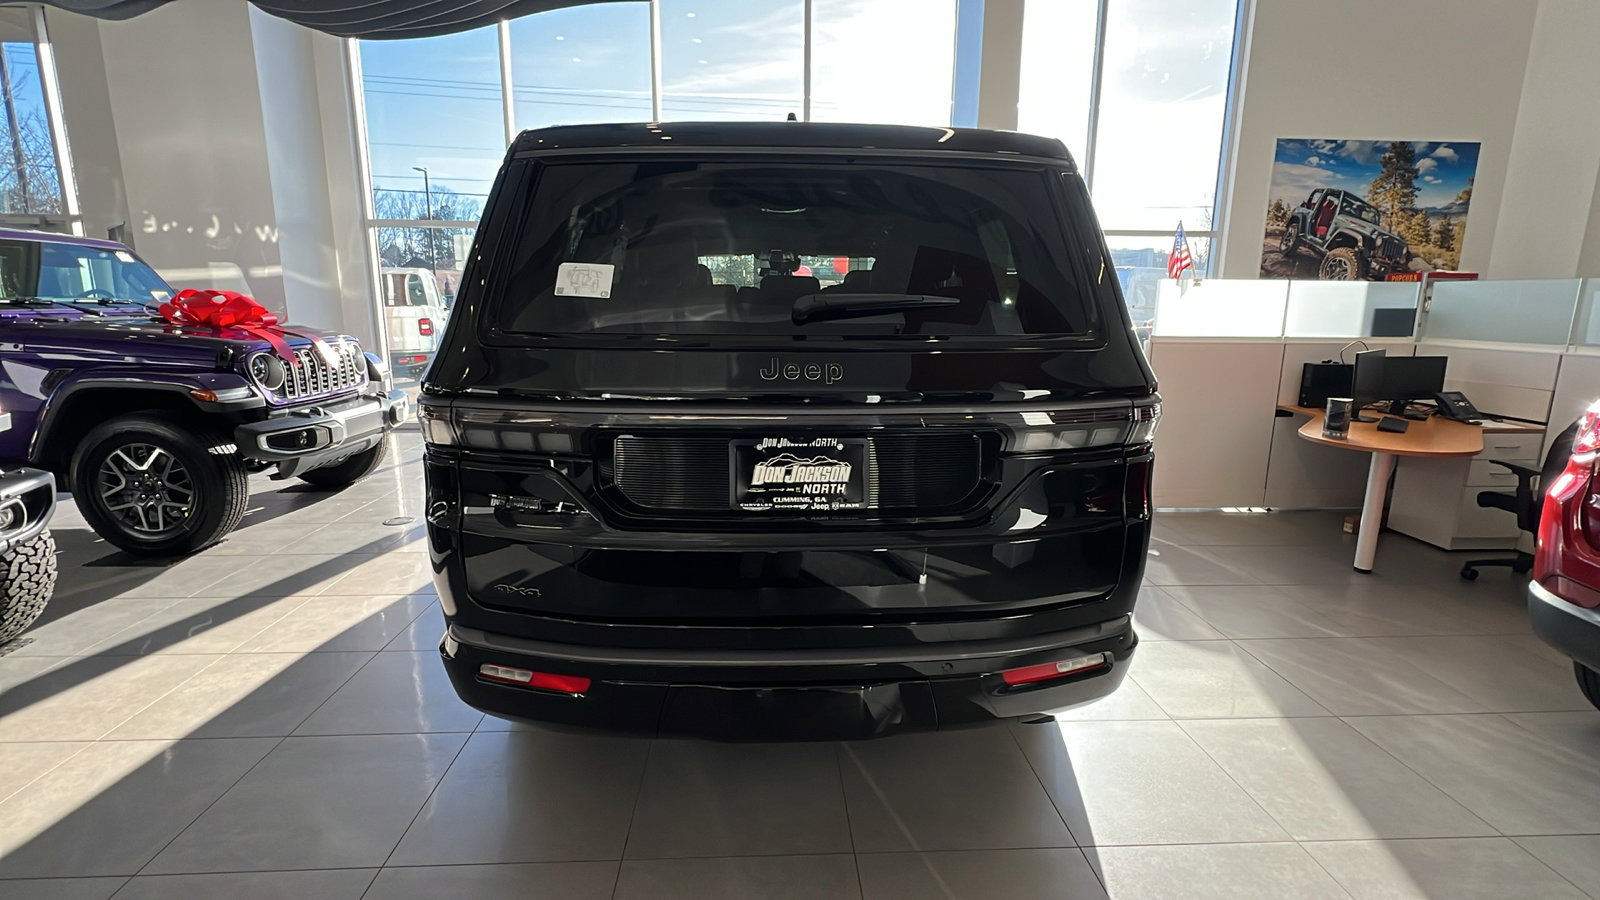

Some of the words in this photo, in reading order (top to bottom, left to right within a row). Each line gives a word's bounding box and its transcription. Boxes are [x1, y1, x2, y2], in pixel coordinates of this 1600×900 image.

[760, 358, 843, 385] Jeep
[762, 438, 777, 448] DON
[751, 465, 785, 485] DON
[785, 465, 852, 483] JACKSON
[803, 484, 845, 494] NORTH
